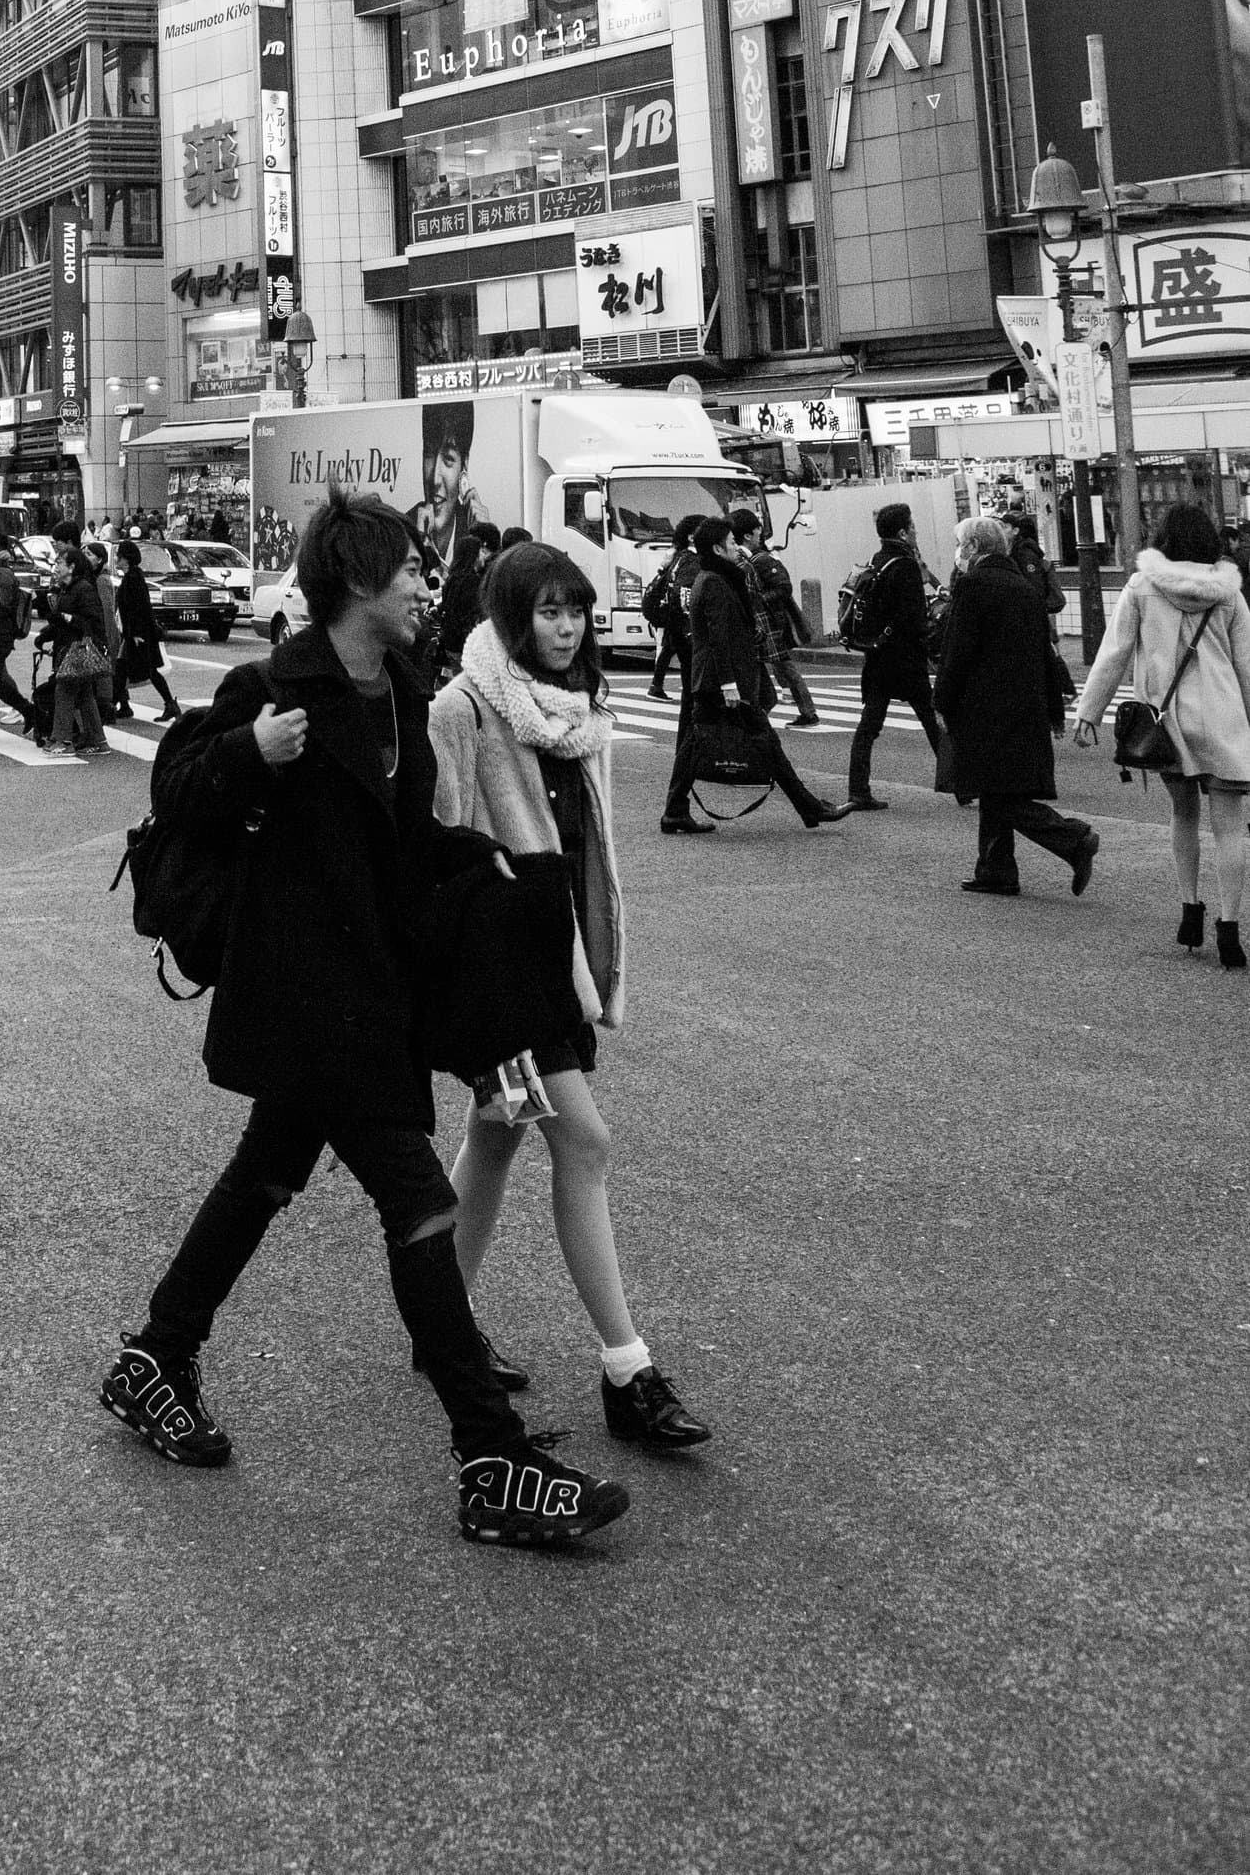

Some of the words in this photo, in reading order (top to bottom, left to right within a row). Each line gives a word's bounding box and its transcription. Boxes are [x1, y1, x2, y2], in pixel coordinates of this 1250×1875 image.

[164, 12, 225, 41] Matsumoto
[225, 1, 252, 22] KiYo
[607, 9, 664, 32] Euphoria
[262, 39, 285, 57] JTB
[413, 13, 588, 82] Euphoria
[614, 99, 673, 161] JTB
[182, 117, 241, 208] 薬
[477, 201, 531, 227] 海外旅行
[541, 198, 603, 222] ウエディング
[544, 185, 599, 206] ハネムーン
[417, 211, 466, 237] 国内旅行
[63, 222, 77, 284] MIZUHO
[1151, 246, 1222, 328] 盛
[1007, 315, 1040, 326] SHIBUYA
[62, 330, 76, 398] みずほ銀行
[420, 369, 473, 391] 渋谷西村
[1062, 352, 1084, 442] 文化村通り
[289, 450, 313, 485] It's
[315, 448, 365, 493] Lucky
[367, 448, 402, 493] Day
[113, 1358, 196, 1442] AIR
[461, 1457, 583, 1518] AIR
